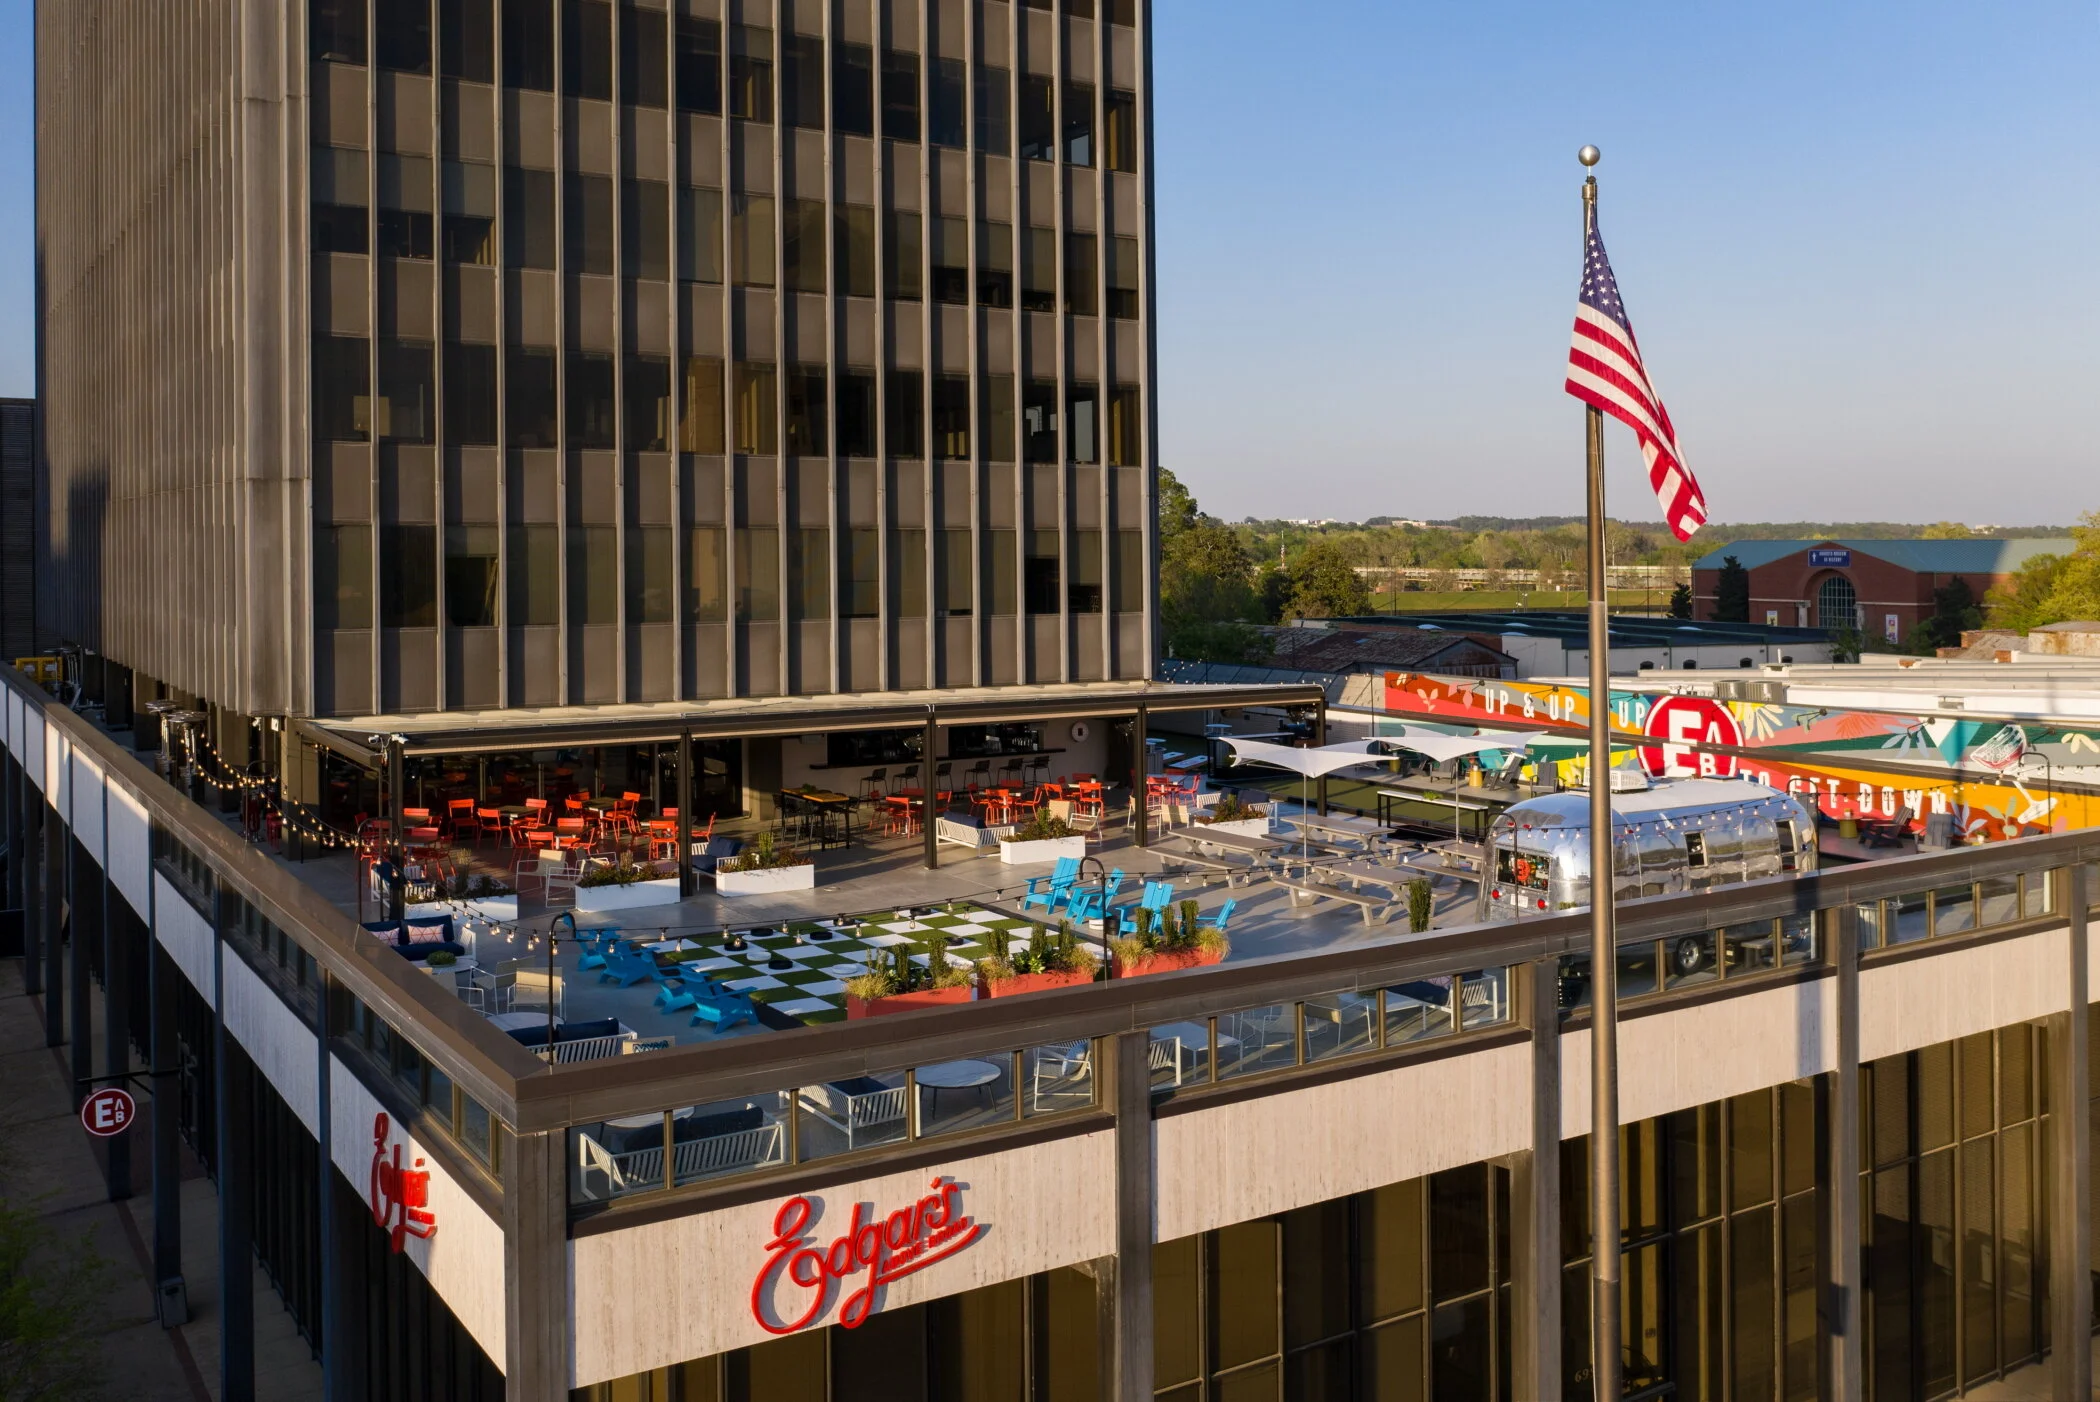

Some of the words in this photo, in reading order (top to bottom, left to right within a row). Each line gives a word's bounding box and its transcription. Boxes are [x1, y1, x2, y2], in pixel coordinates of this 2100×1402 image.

[1485, 688, 1509, 715] UP
[1523, 692, 1535, 719] &
[1549, 694, 1575, 722] UP
[1618, 700, 1646, 729] UP
[1859, 782, 1946, 819] DOWN
[751, 1176, 959, 1335] Edgar's
